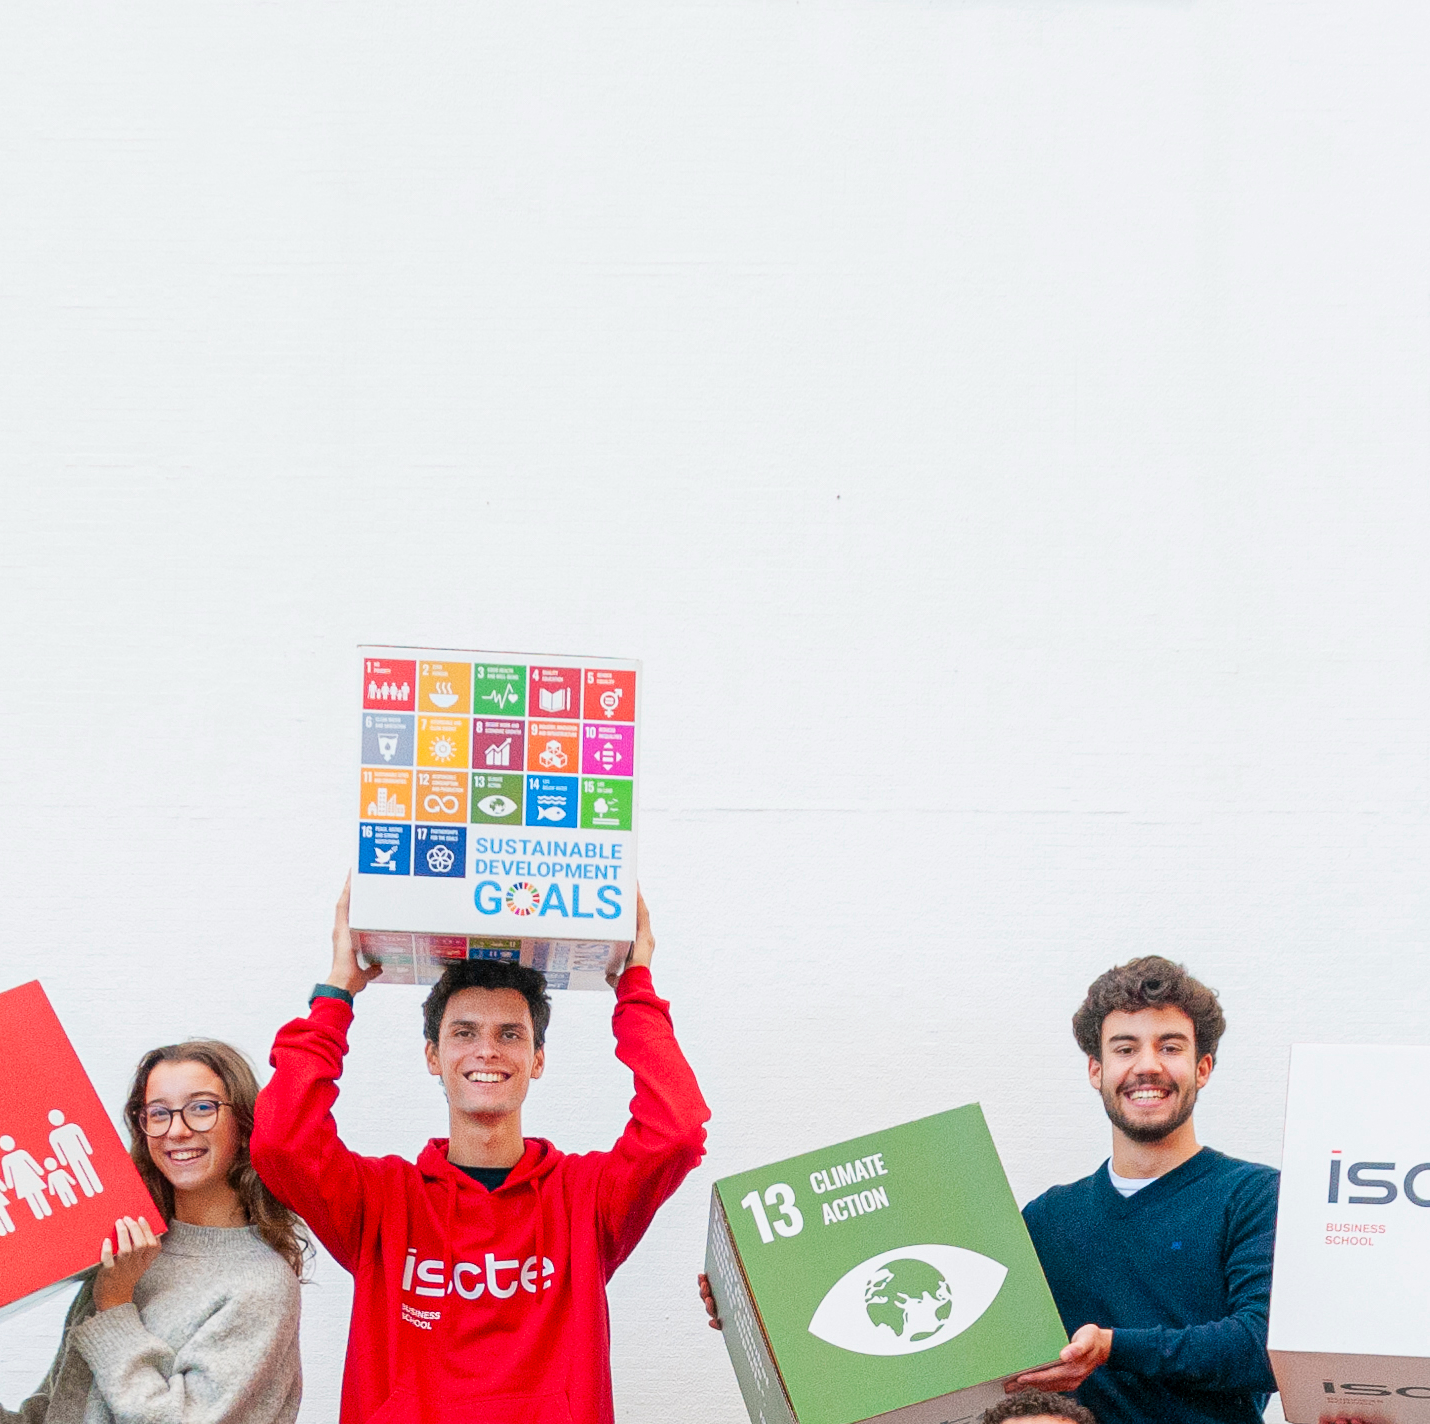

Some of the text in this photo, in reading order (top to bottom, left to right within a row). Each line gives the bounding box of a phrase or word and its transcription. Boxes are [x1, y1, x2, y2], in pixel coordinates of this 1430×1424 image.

[366, 661, 372, 673] 1
[422, 664, 429, 676] 2
[477, 666, 485, 679] 3
[532, 669, 539, 681] 4
[587, 672, 594, 684] 5
[365, 716, 373, 728] 6
[421, 719, 427, 730] 7
[476, 721, 483, 733] 8
[531, 724, 538, 736] 9
[585, 726, 596, 739] 10
[363, 771, 373, 783] 11
[419, 774, 429, 785] 12
[474, 776, 485, 788] 13
[529, 778, 539, 790] 14
[584, 781, 594, 793] 15
[361, 826, 373, 838] 16
[417, 828, 427, 840] 17
[475, 837, 622, 860] SUSTAINABLE
[475, 859, 622, 880] DEVELOPMENT
[474, 880, 622, 919] GOALS
[809, 1152, 889, 1195] CLIMATE
[821, 1186, 890, 1226] ACTION
[741, 1182, 805, 1244] 13
[1325, 1222, 1387, 1234] BUSINESS
[1324, 1235, 1375, 1246] SCHOOL
[402, 1247, 555, 1300] iscte
[402, 1302, 441, 1320] BUSINESS
[402, 1312, 432, 1330] SCHOOL
